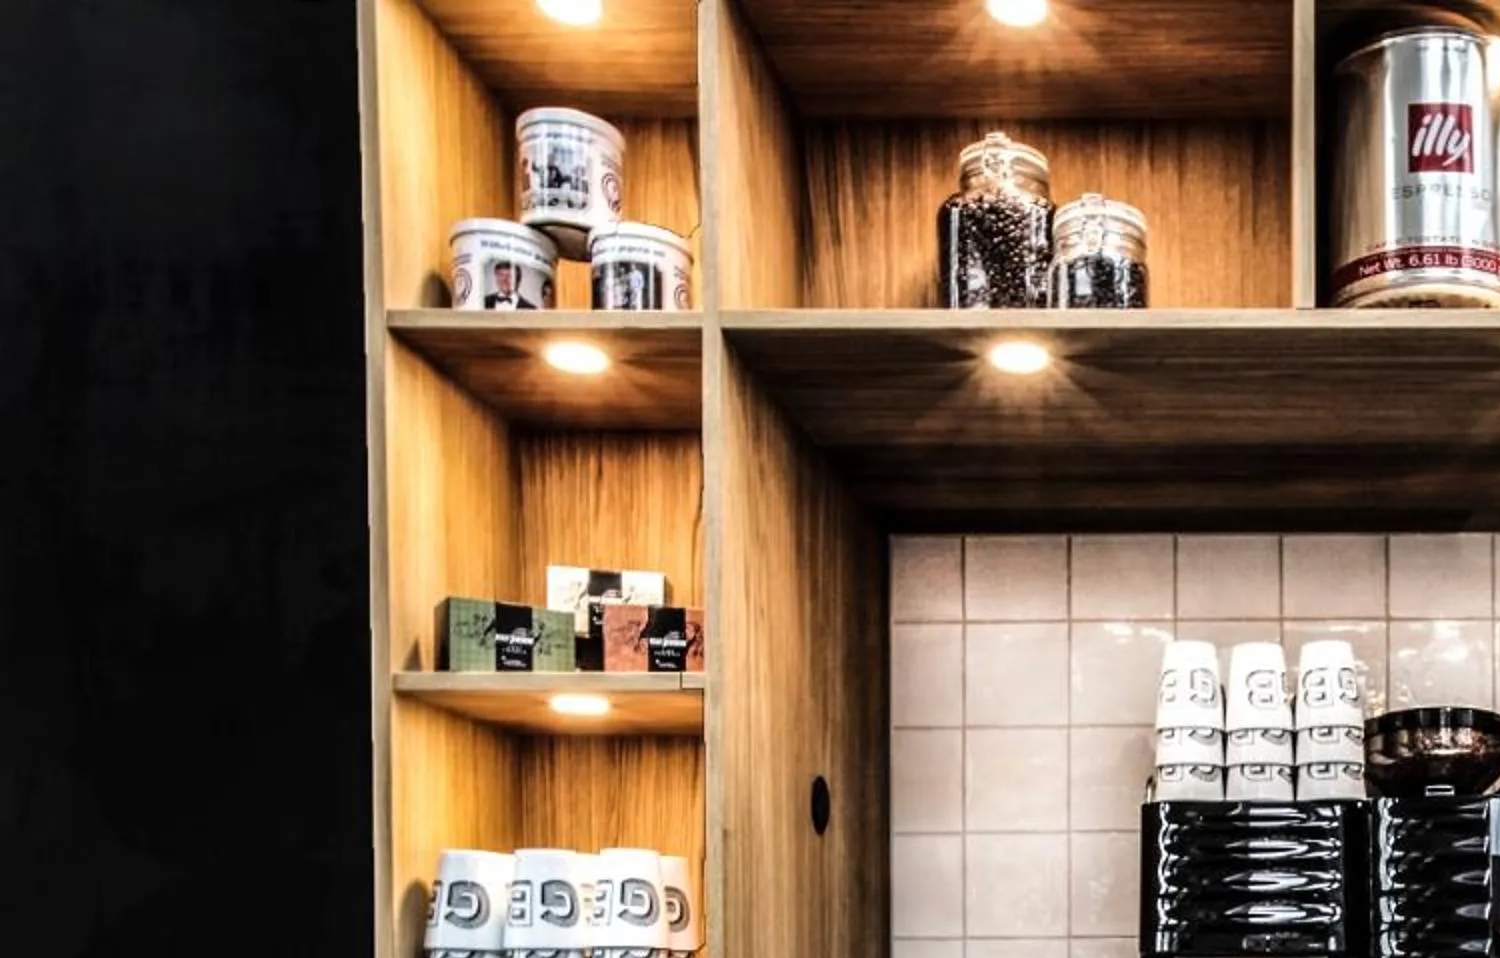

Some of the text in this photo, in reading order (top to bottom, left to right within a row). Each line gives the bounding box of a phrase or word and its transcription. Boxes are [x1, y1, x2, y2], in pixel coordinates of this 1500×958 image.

[1412, 113, 1471, 166] illy
[1409, 253, 1440, 267] 6.61
[1446, 255, 1459, 266] lb
[1246, 669, 1289, 709] B
